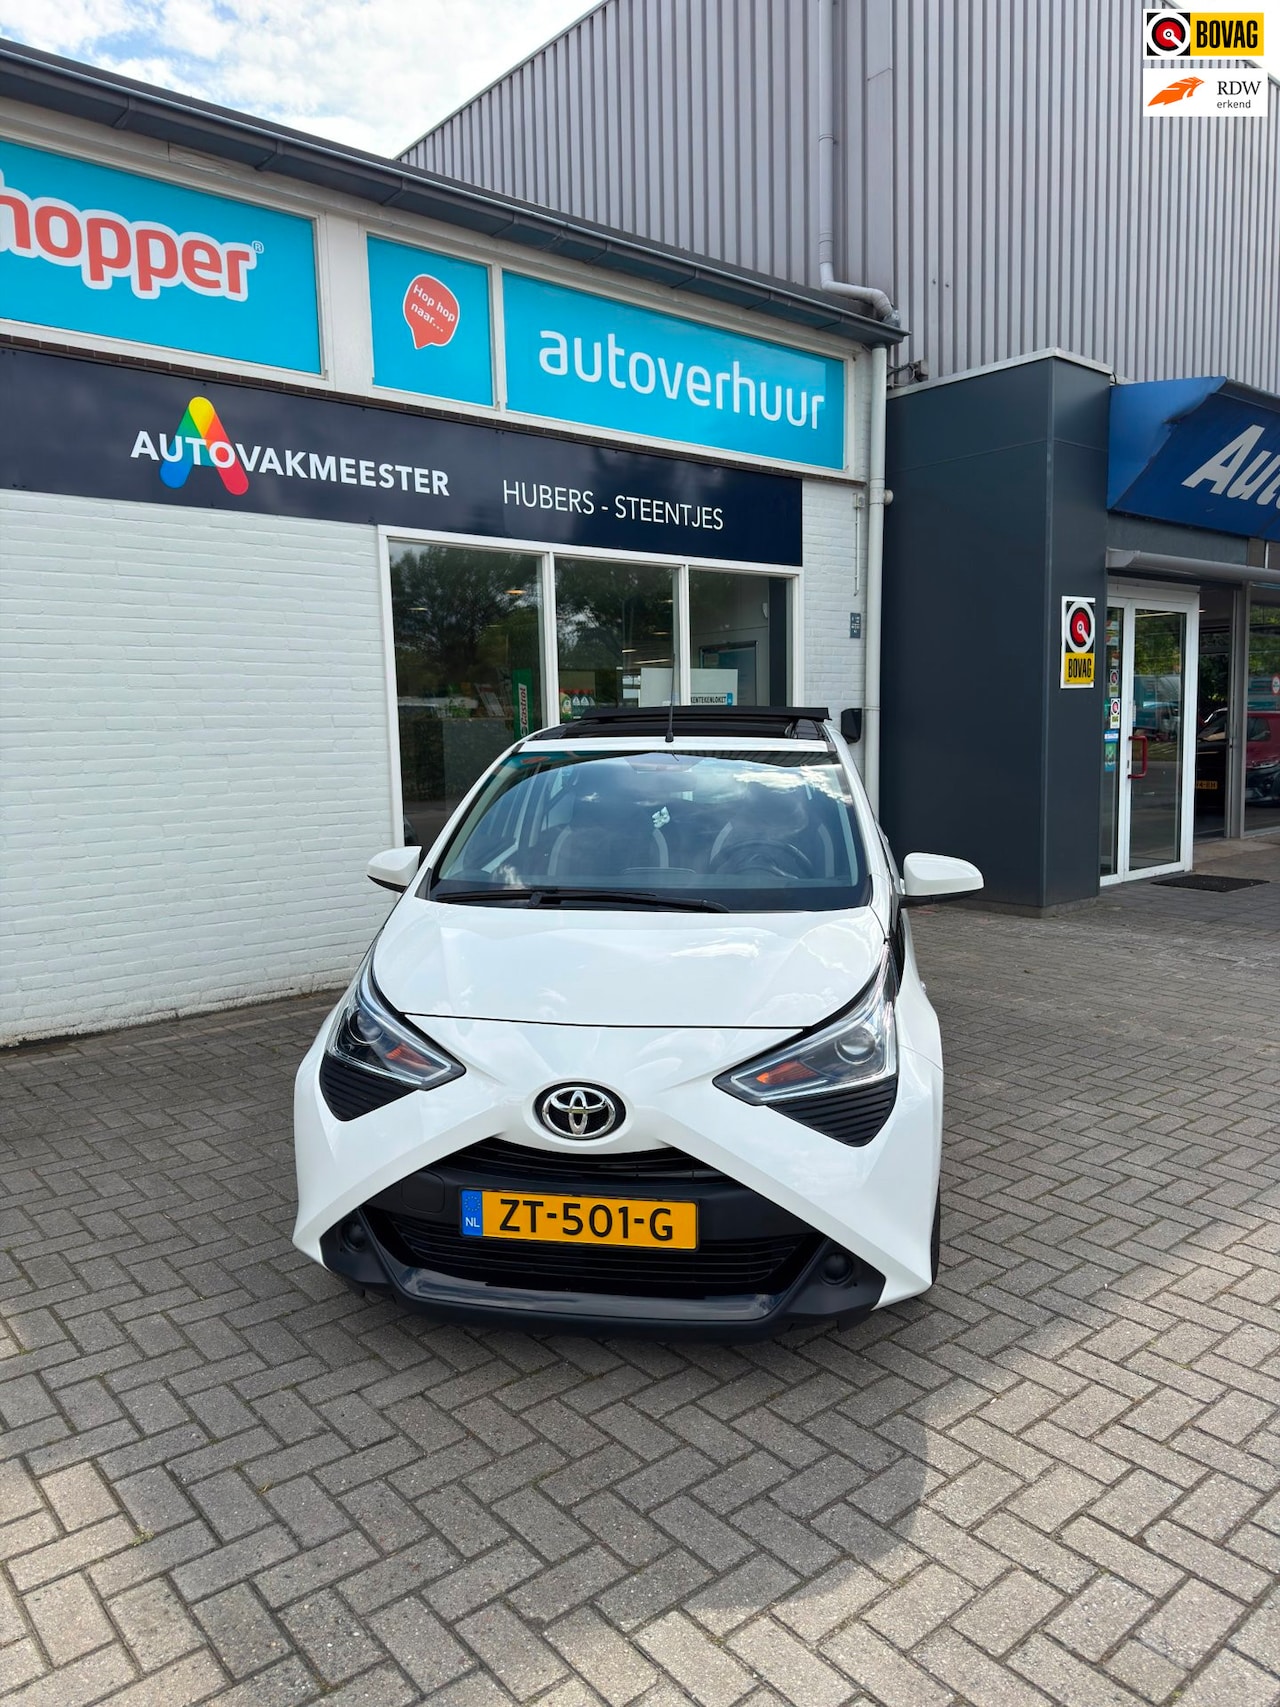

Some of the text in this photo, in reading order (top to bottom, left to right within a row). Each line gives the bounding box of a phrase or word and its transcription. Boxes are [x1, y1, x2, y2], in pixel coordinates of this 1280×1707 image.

[413, 284, 456, 322] Hop hop
[538, 330, 825, 430] autoverhuur
[130, 430, 451, 497] AUTOVAKMEESTER
[503, 479, 595, 515] HUBERS
[614, 494, 724, 531] STEENTJES
[1068, 658, 1092, 678] BOVAG
[519, 687, 528, 727] Castrol
[465, 1198, 673, 1242] NL ZT-501-G
